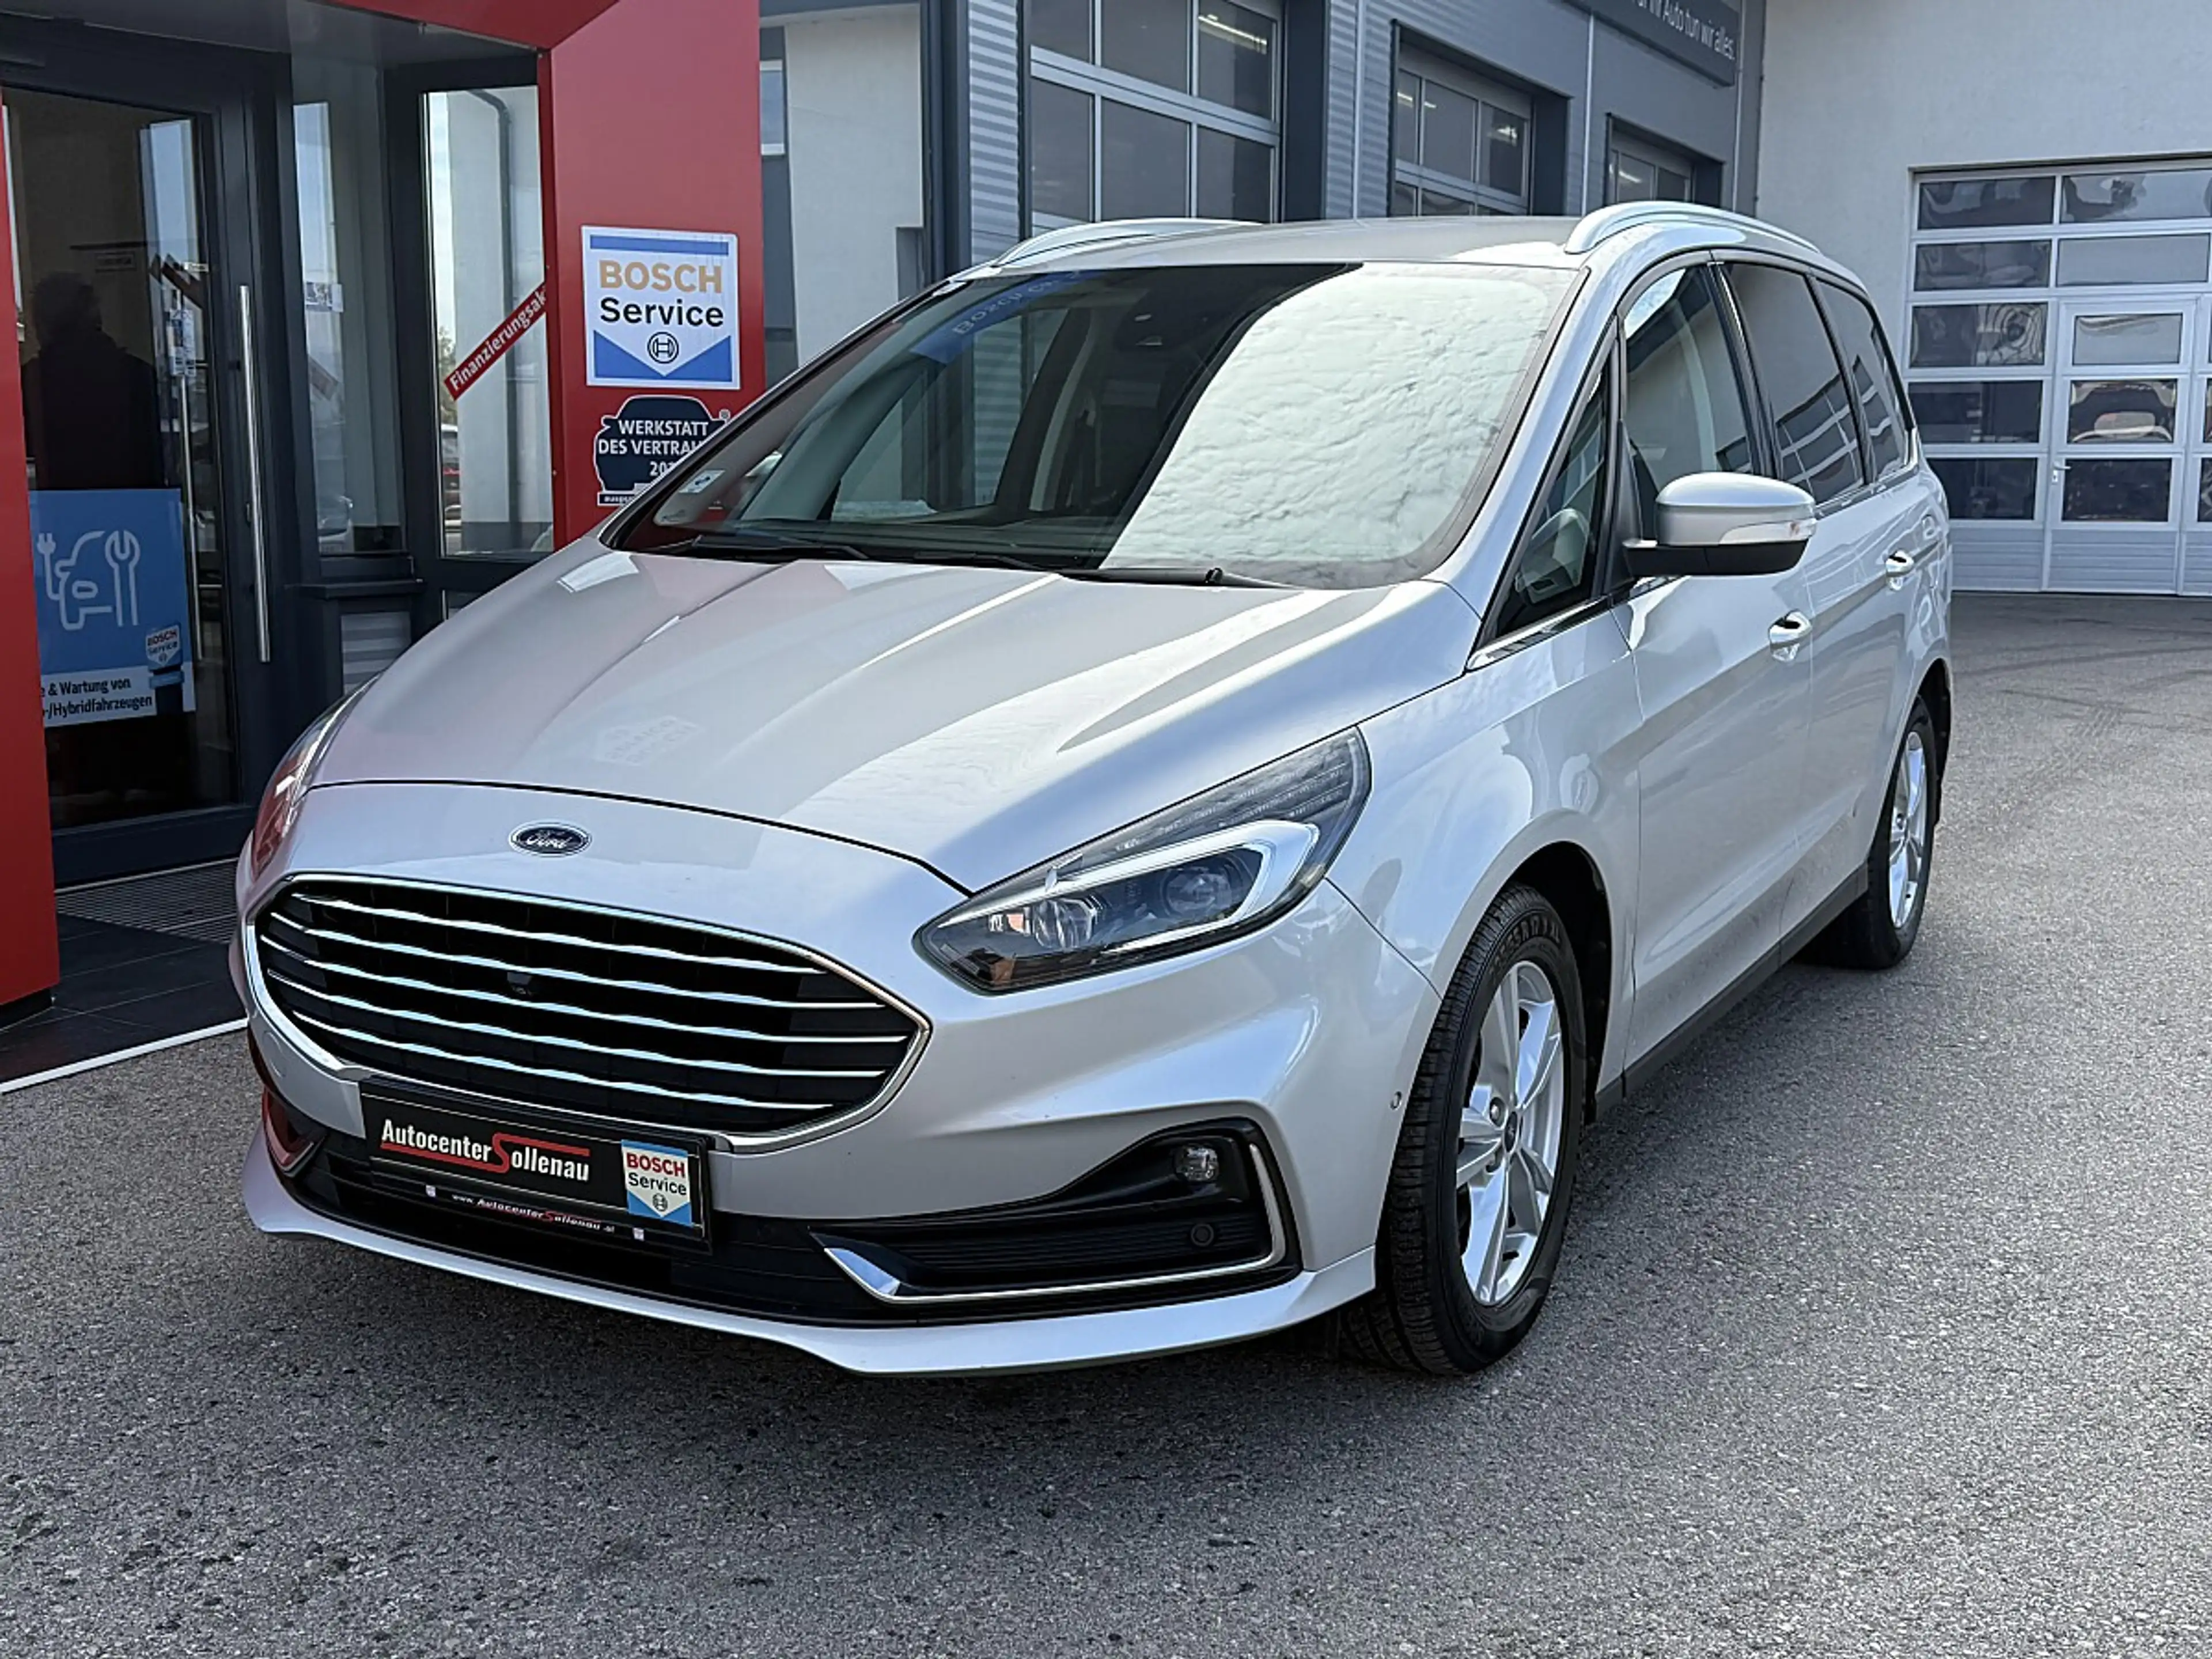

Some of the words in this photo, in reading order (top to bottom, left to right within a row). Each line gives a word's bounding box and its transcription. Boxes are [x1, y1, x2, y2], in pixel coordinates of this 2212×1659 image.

[599, 259, 723, 294] BOSCH
[600, 297, 724, 327] Service
[618, 420, 709, 436] WERKSTATT
[599, 439, 627, 454] DES
[48, 681, 58, 696] &
[59, 680, 109, 696] Wartung
[109, 678, 131, 690] von
[525, 830, 573, 849] Ford
[626, 1152, 685, 1177] BOSCH
[628, 1172, 687, 1195] Service
